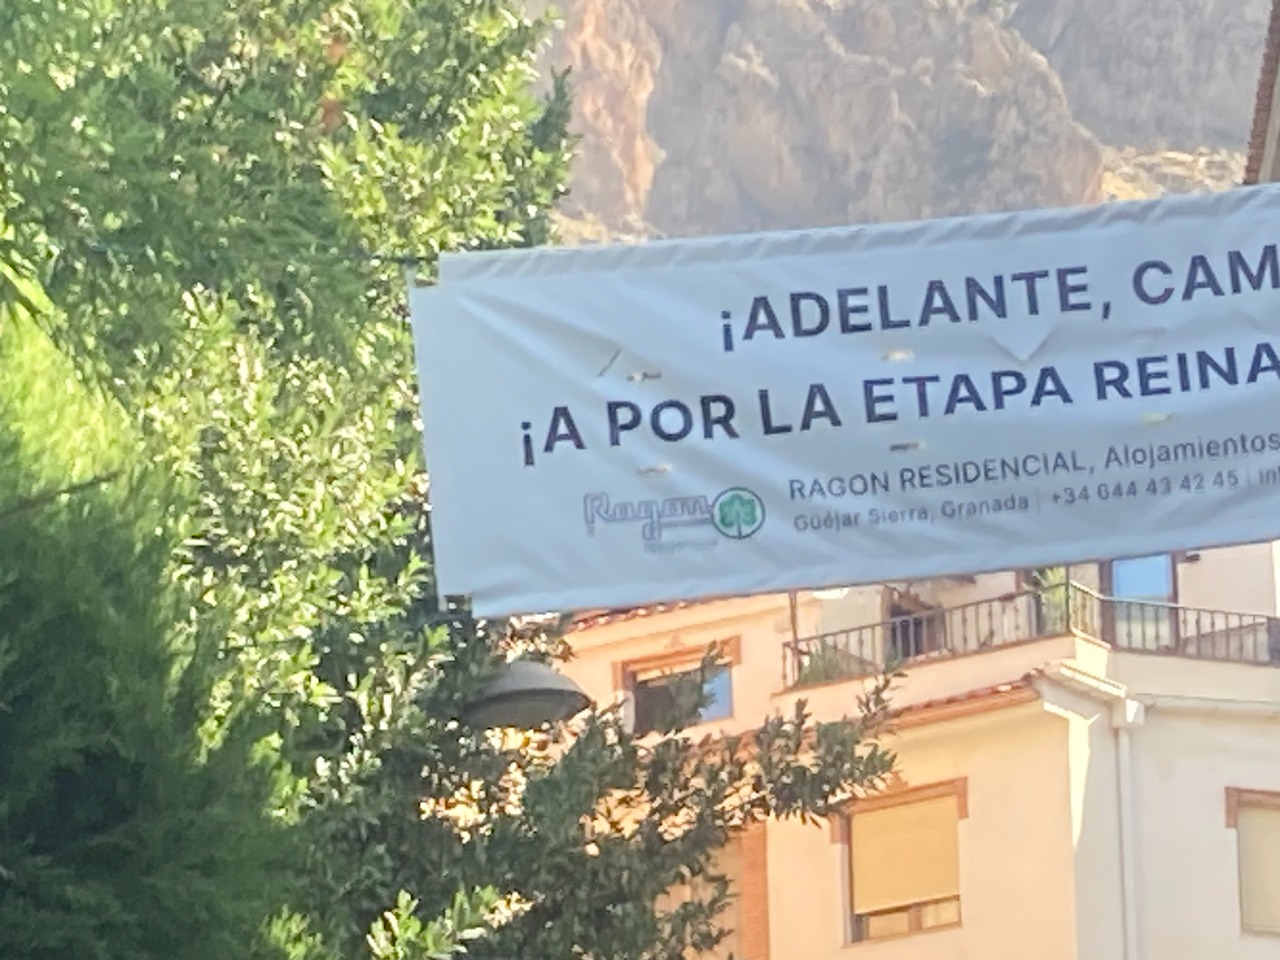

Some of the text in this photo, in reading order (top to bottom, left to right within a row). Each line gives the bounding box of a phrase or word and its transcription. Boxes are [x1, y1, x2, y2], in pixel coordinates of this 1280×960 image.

[720, 265, 1112, 352] ¡ADELANTE,
[520, 405, 585, 466] ¡A
[607, 394, 740, 447] POR
[758, 383, 842, 436] LA
[863, 365, 1073, 424] ETAPA
[788, 471, 890, 501] RAGON
[899, 450, 1095, 492] RESIDENCIAL,
[941, 493, 1029, 519] Granada
[1052, 485, 1090, 504] +34
[1180, 473, 1204, 491] 42
[1212, 469, 1239, 489] 45
